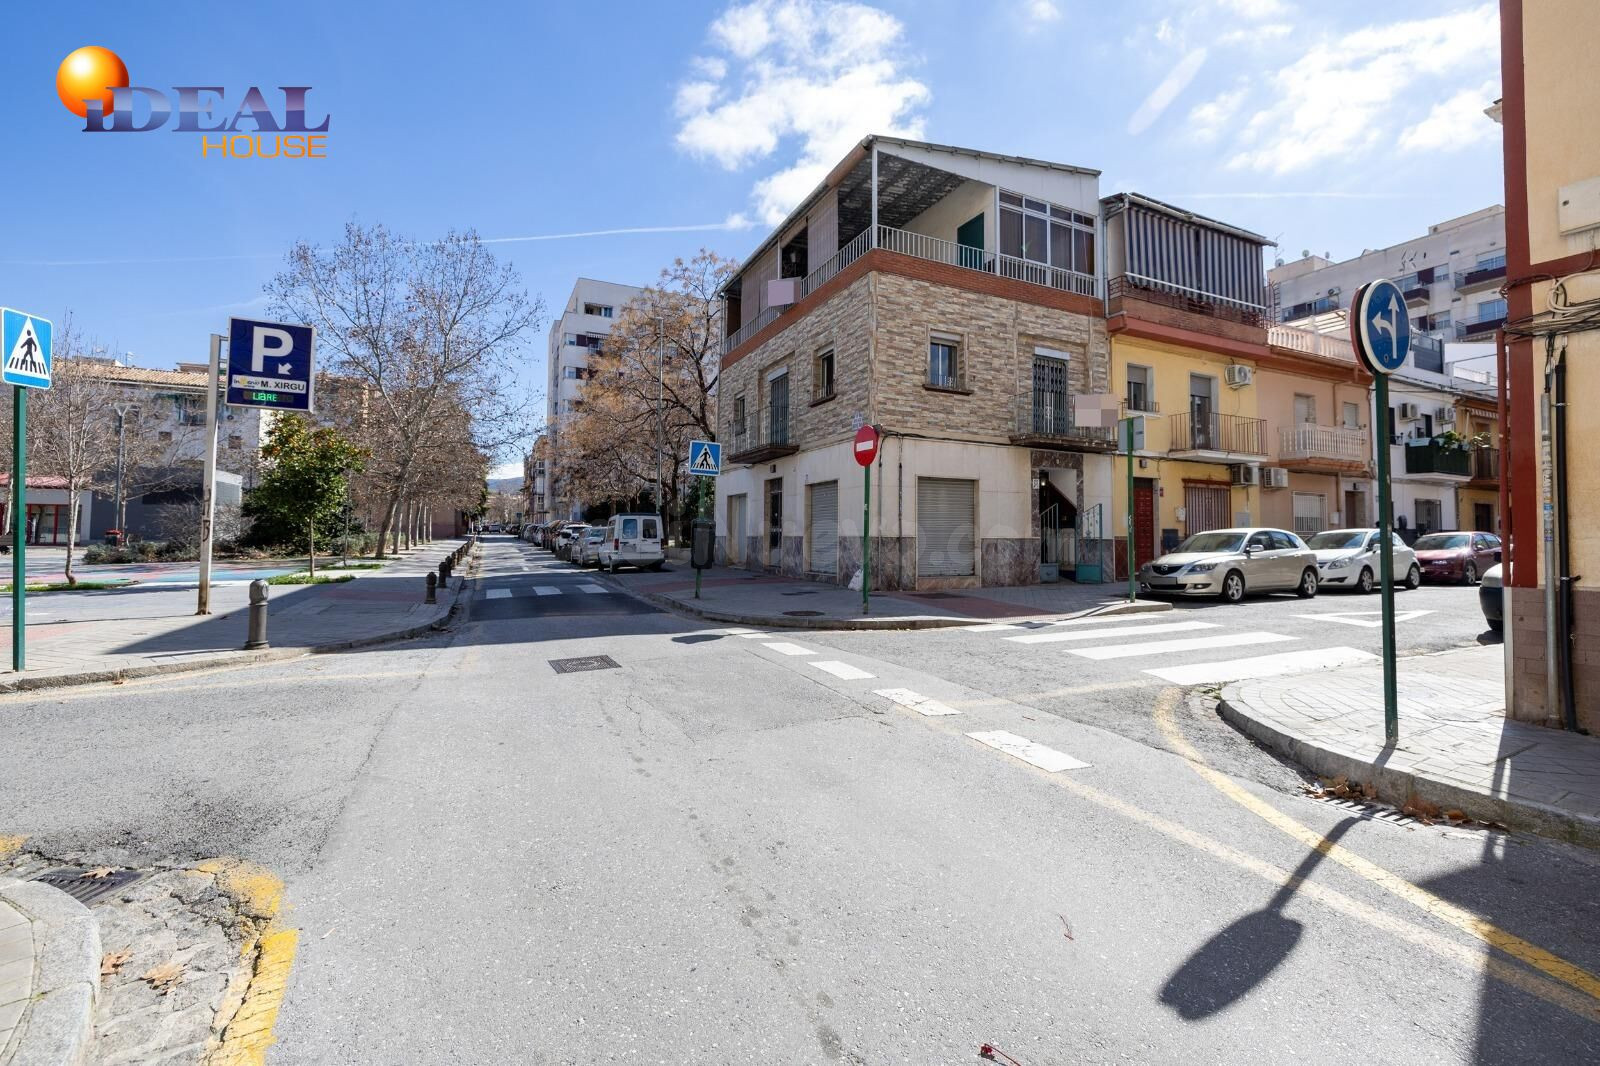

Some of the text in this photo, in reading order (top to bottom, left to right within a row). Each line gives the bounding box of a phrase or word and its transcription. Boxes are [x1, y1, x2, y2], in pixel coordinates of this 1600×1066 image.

[251, 326, 294, 372] P
[260, 380, 271, 388] M.
[274, 381, 305, 391] XIRGU
[252, 392, 277, 402] LIBRE
